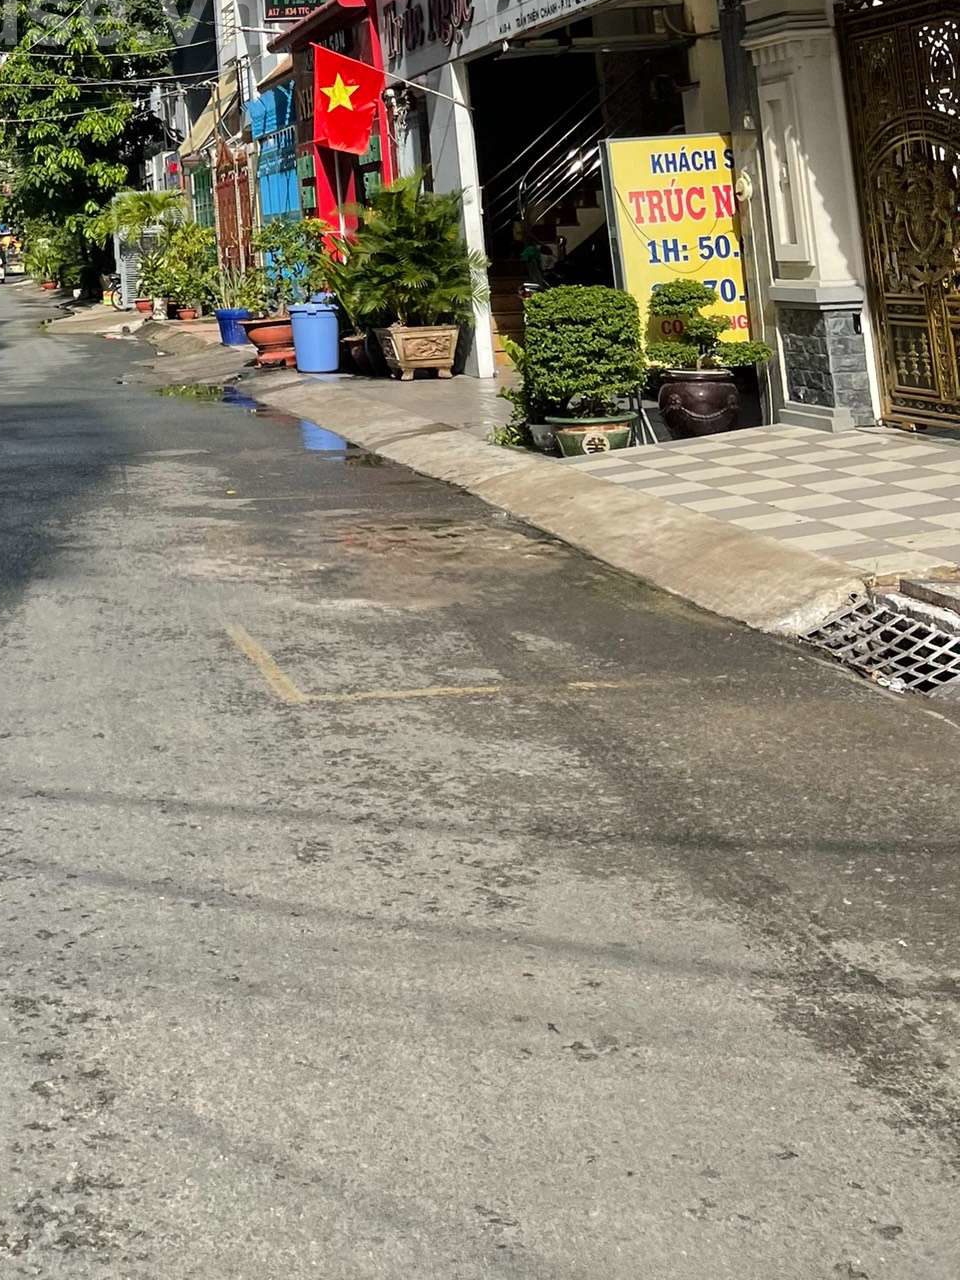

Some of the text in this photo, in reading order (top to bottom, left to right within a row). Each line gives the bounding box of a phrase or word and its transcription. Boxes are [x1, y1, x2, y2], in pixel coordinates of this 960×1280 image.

[650, 146, 717, 174] KHÁCH
[629, 178, 706, 224] TRÚC
[647, 239, 689, 264] 1H:
